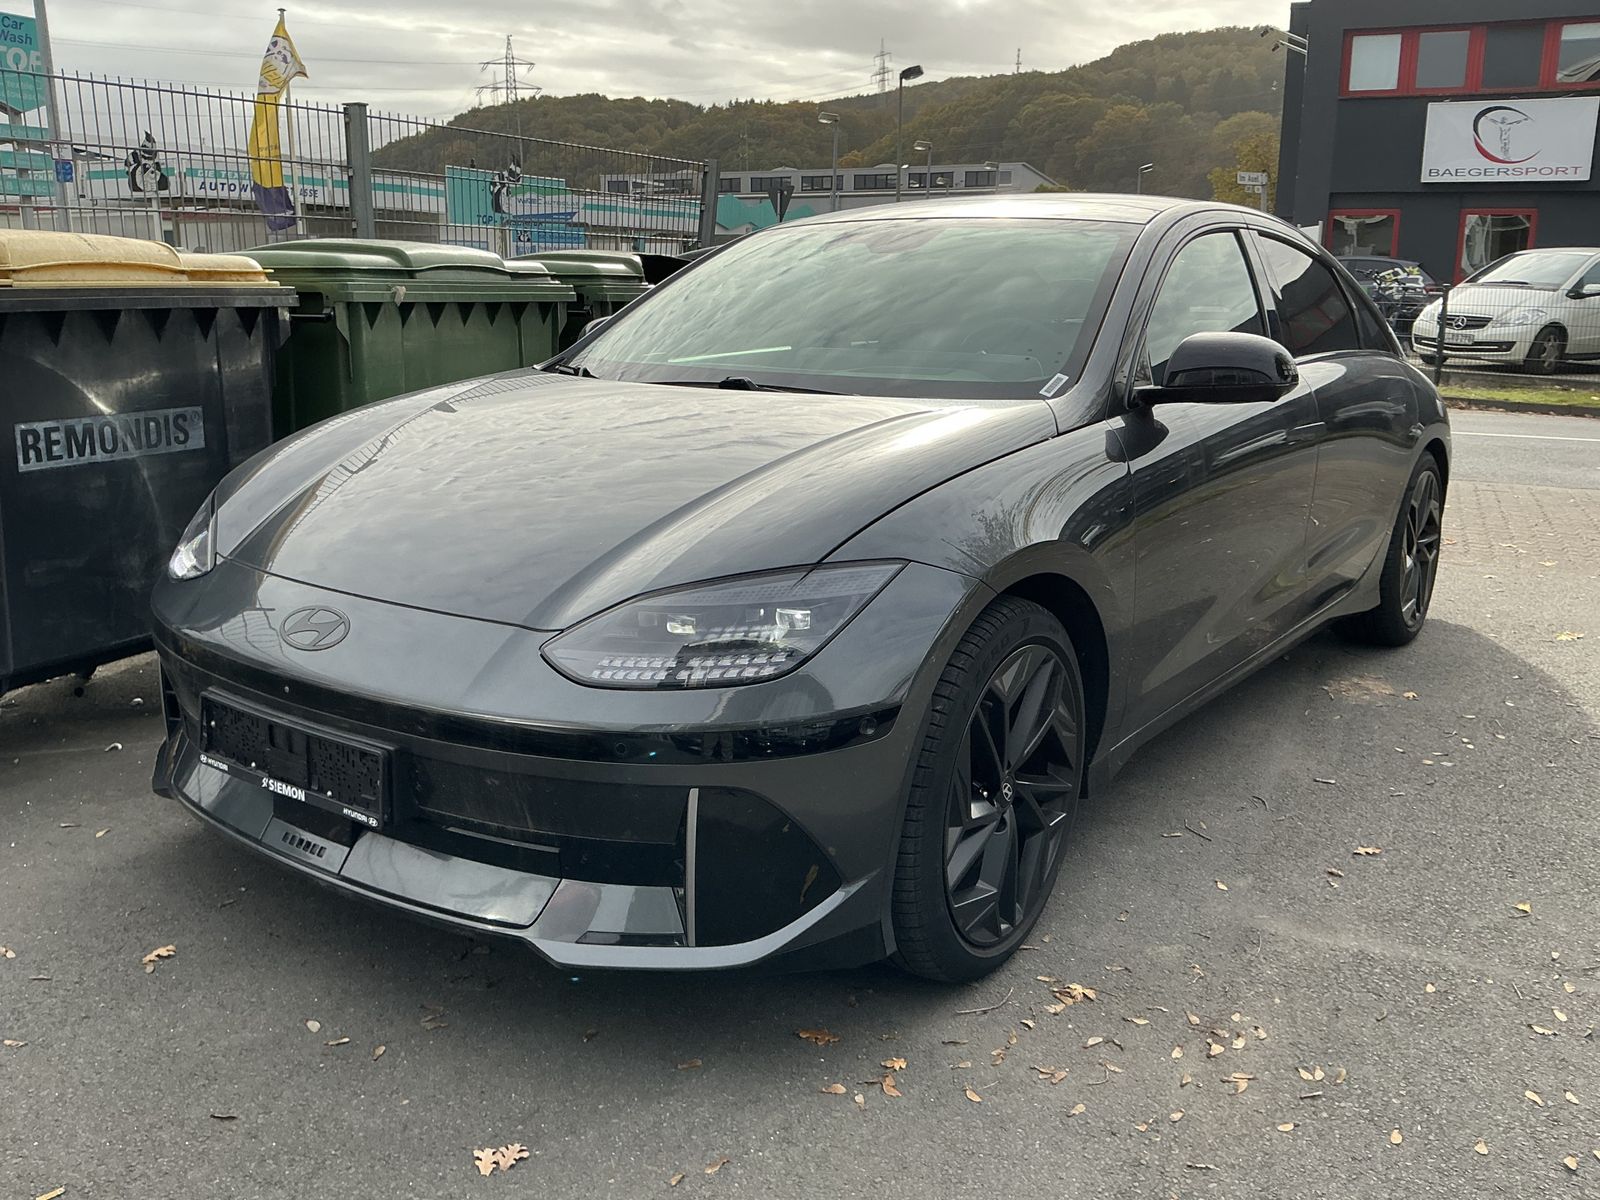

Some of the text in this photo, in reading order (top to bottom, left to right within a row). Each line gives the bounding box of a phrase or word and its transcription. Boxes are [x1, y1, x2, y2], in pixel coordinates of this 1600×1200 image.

[1, 15, 24, 30] Car
[1428, 166, 1583, 177] BAEGERSPORT
[19, 413, 190, 466] REMONDIS
[207, 757, 229, 772] HYUNDAI
[268, 778, 306, 802] SIEMON
[343, 806, 368, 824] HYUNDAI
